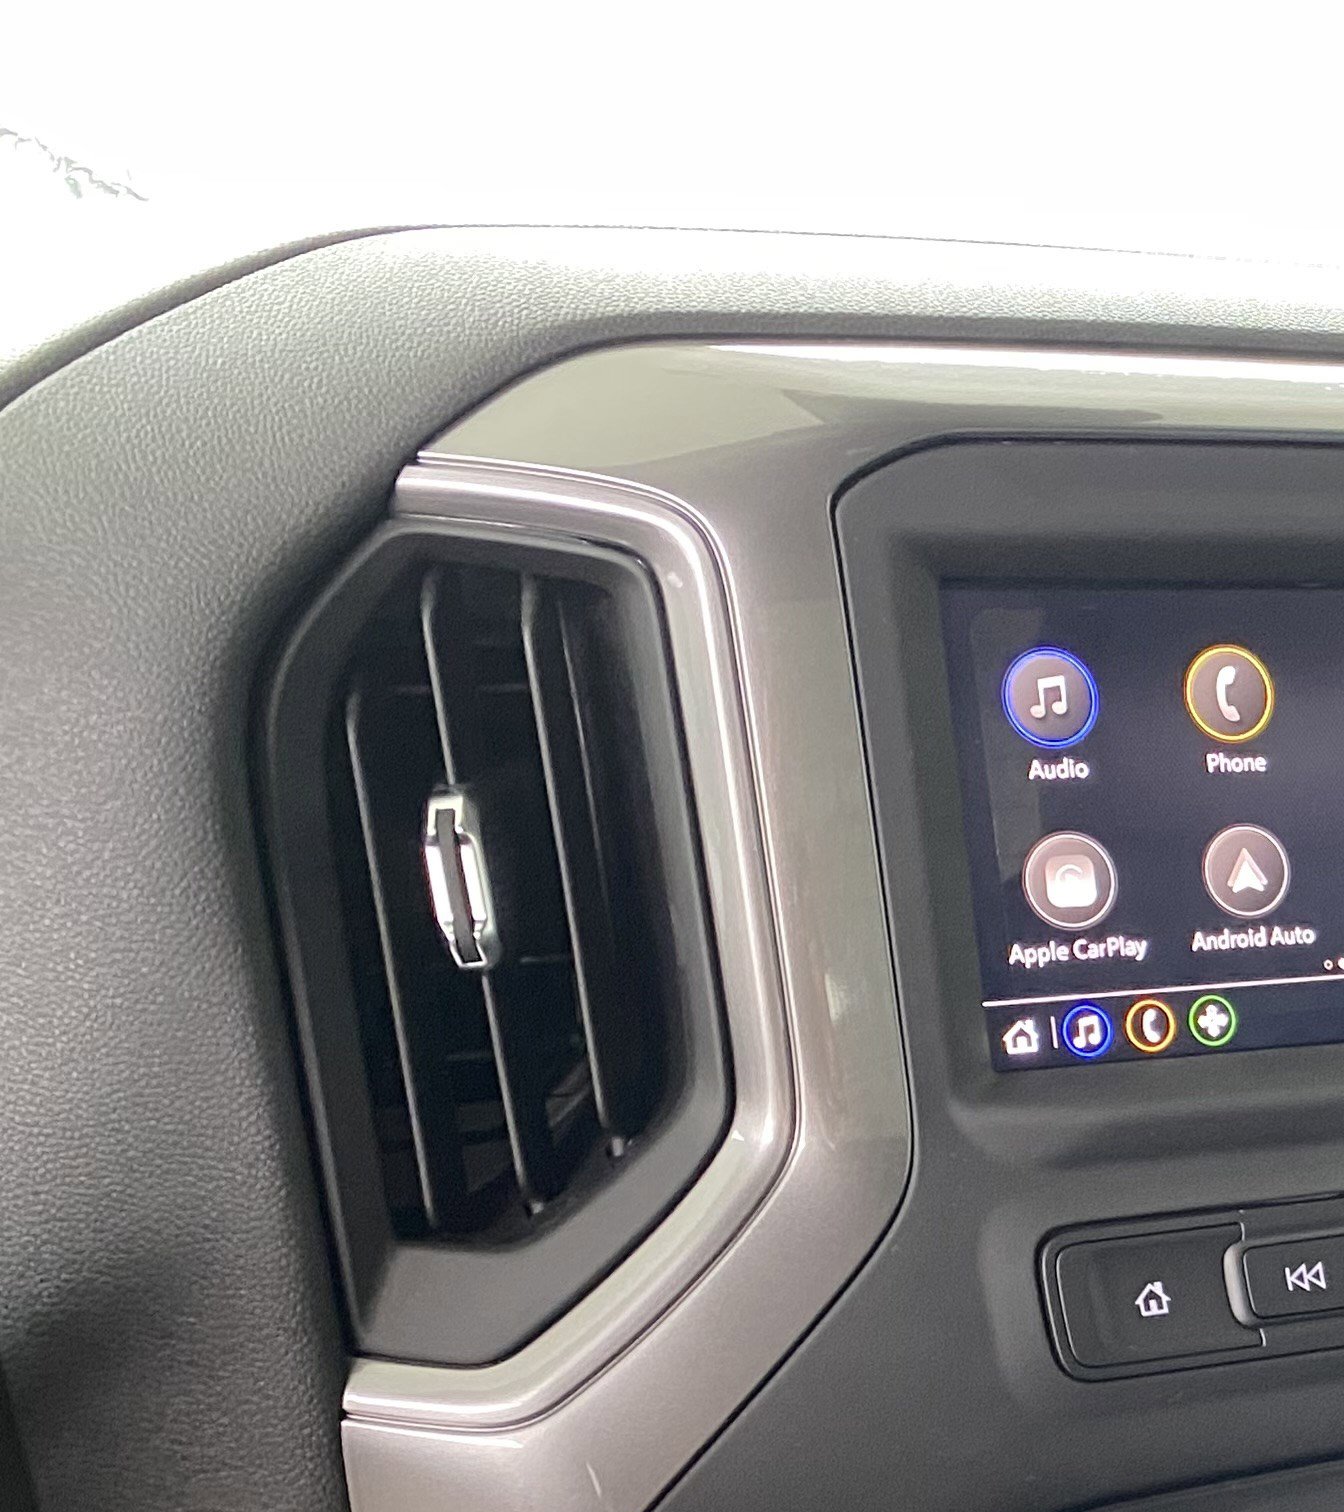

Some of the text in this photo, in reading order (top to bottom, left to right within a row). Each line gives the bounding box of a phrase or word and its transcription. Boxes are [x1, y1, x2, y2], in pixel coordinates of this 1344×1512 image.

[1028, 757, 1090, 780] Audio
[1205, 752, 1267, 774] Phone
[1192, 926, 1316, 952] Android Auto
[1008, 935, 1148, 969] Apple CarPlay
